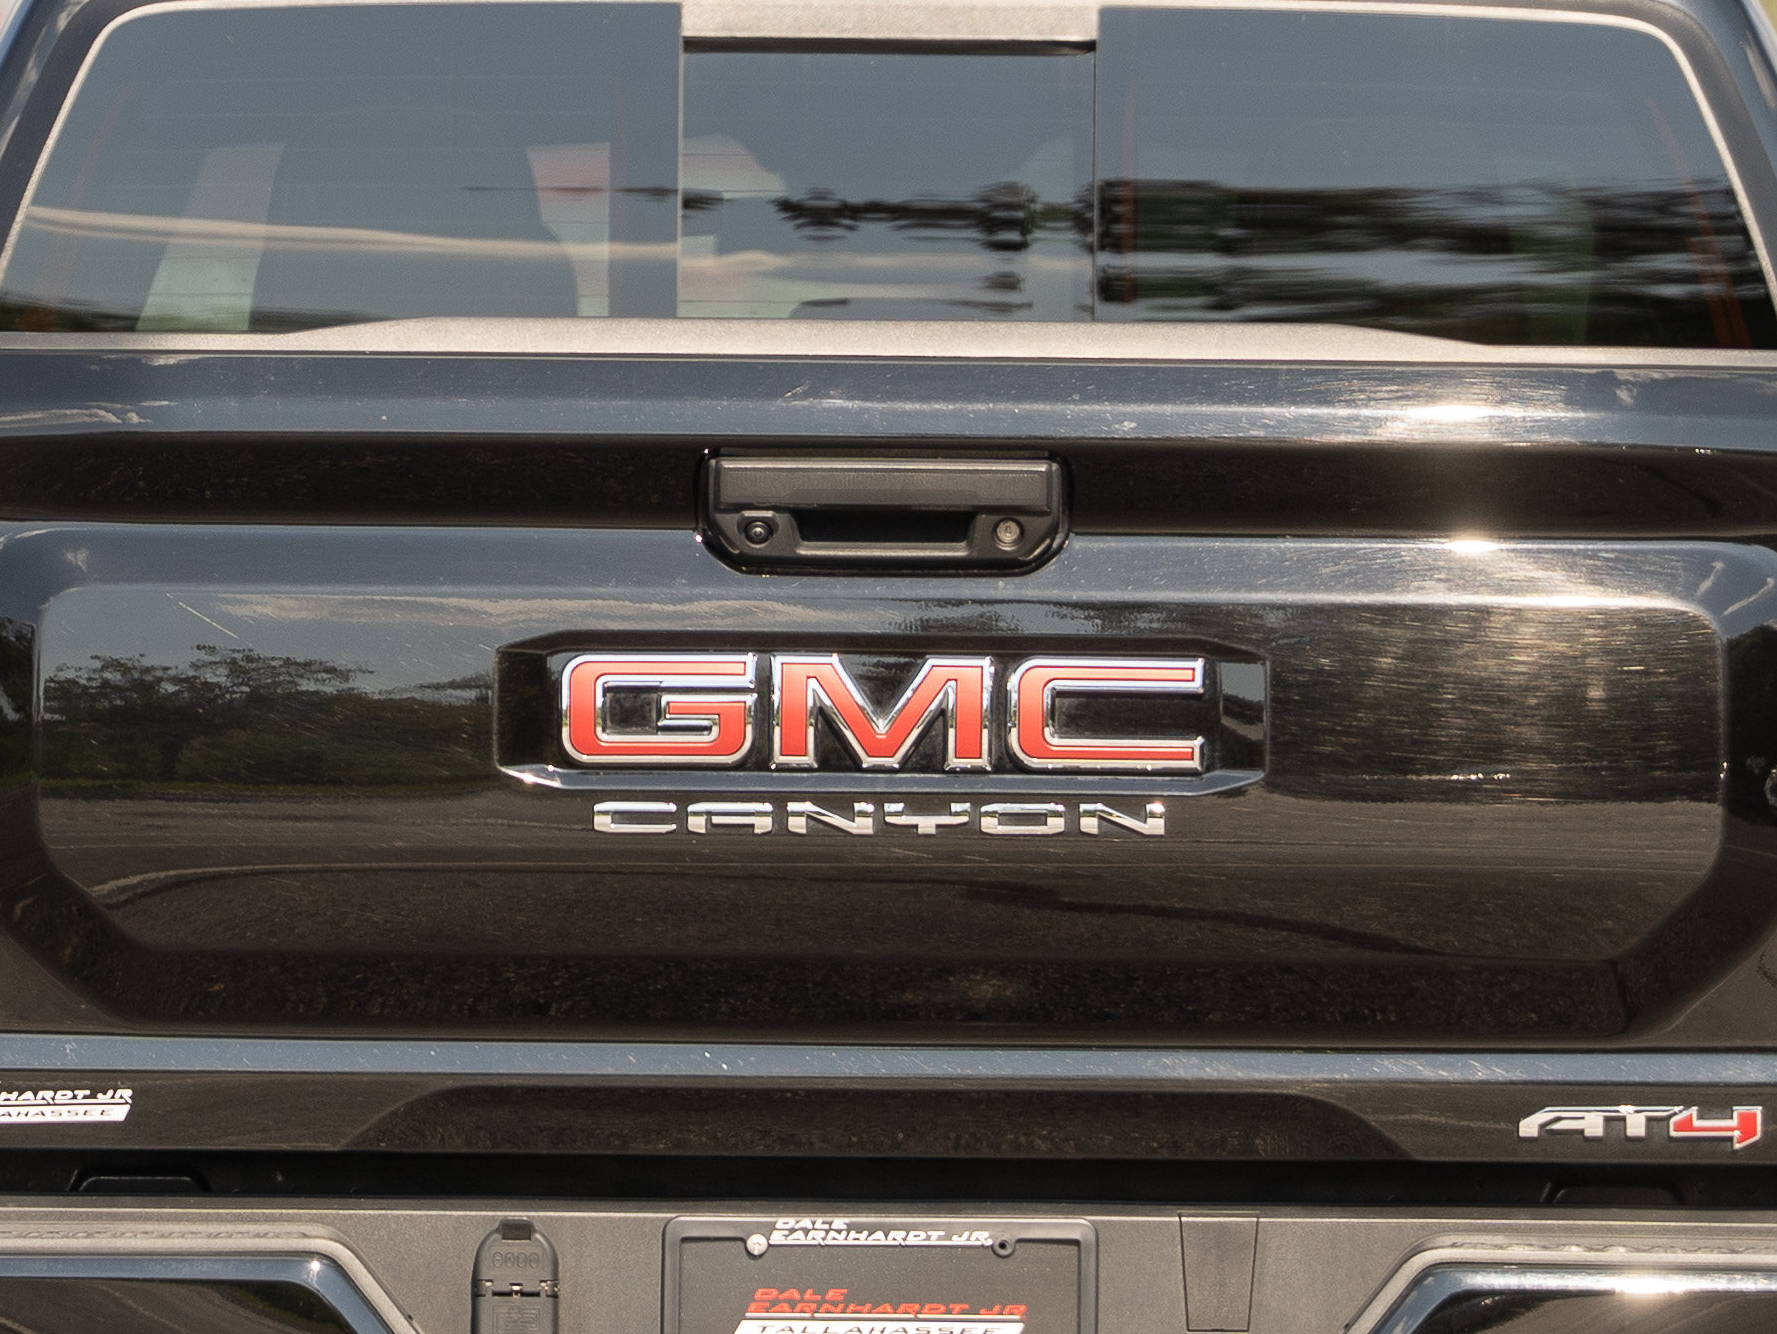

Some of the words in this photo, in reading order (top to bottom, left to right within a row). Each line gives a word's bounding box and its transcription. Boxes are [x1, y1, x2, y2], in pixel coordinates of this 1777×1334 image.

[560, 652, 1206, 775] GMC
[593, 801, 1166, 837] CANYON
[96, 1089, 134, 1104] JR
[1518, 1105, 1764, 1150] AT4
[774, 1218, 851, 1230] DALE
[769, 1230, 946, 1244] EARNHARDT
[753, 1287, 849, 1301] DALE
[746, 1301, 970, 1317] EARNHARDT
[979, 1303, 1028, 1319] JR
